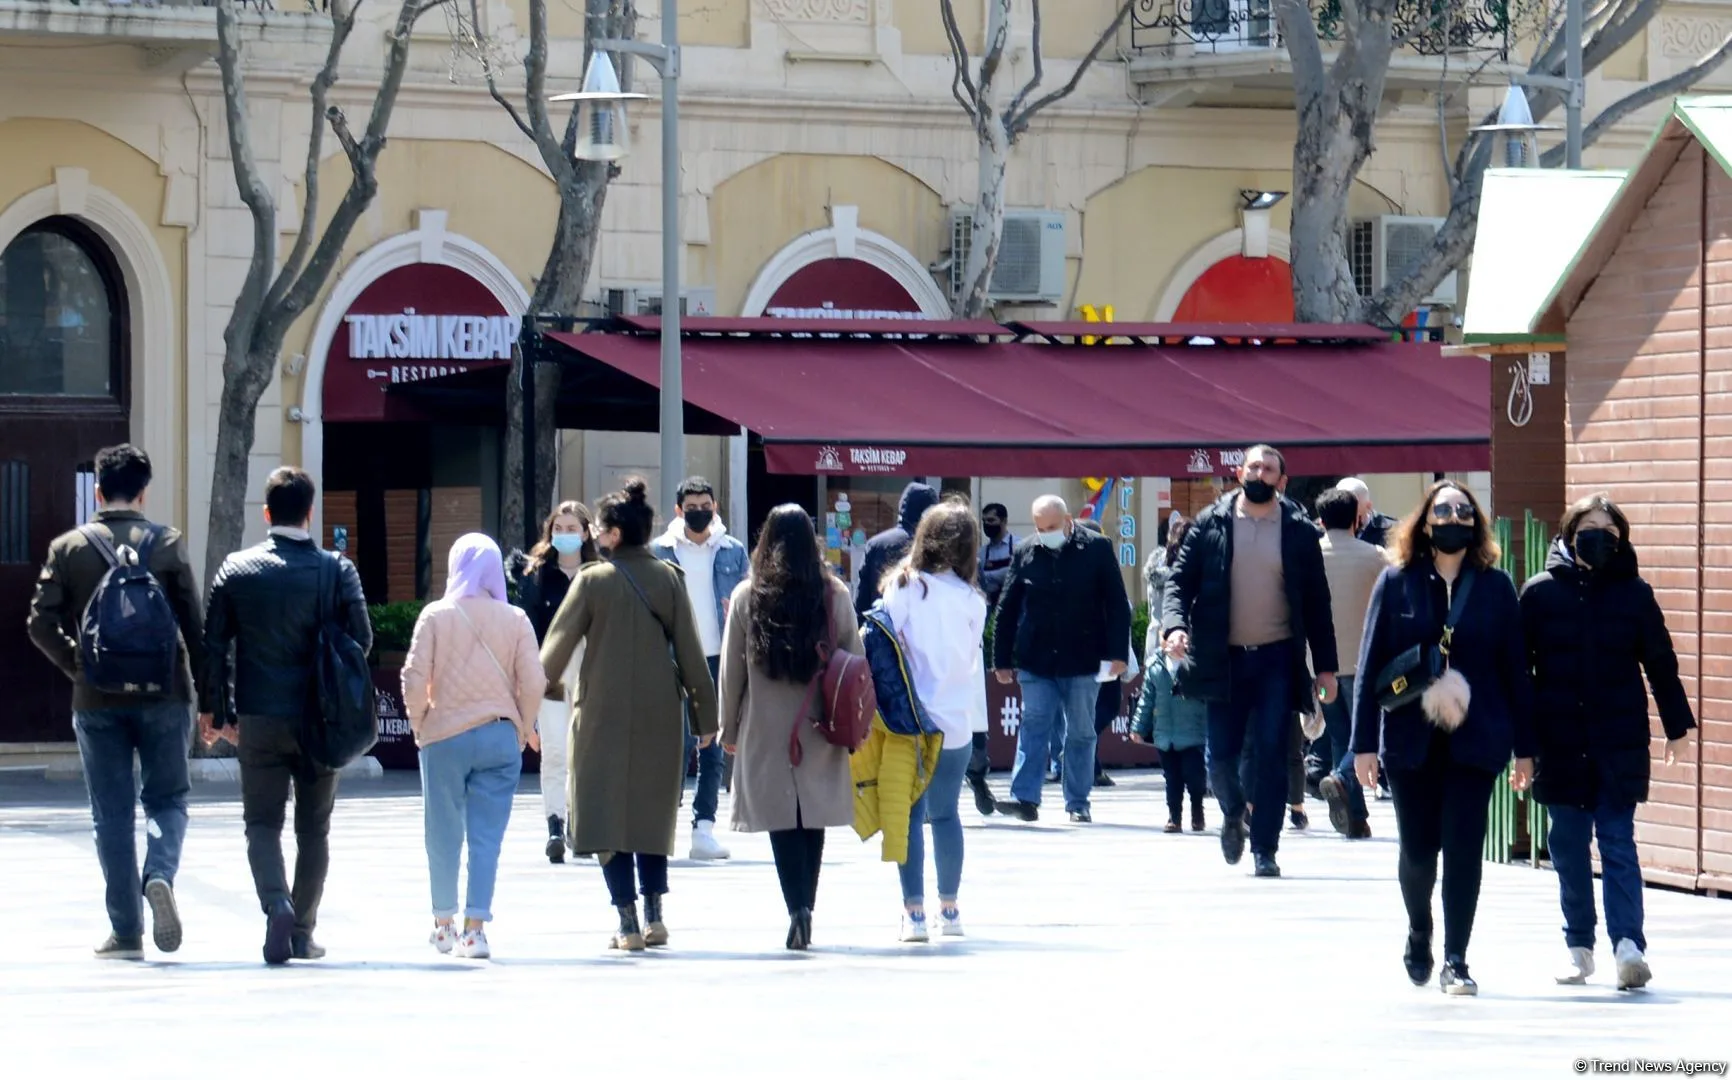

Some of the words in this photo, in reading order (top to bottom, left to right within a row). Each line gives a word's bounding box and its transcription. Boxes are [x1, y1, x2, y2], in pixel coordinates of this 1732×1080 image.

[345, 306, 438, 359] TAKSİM
[438, 314, 523, 359] KEBAP
[880, 448, 907, 466] KEBAP
